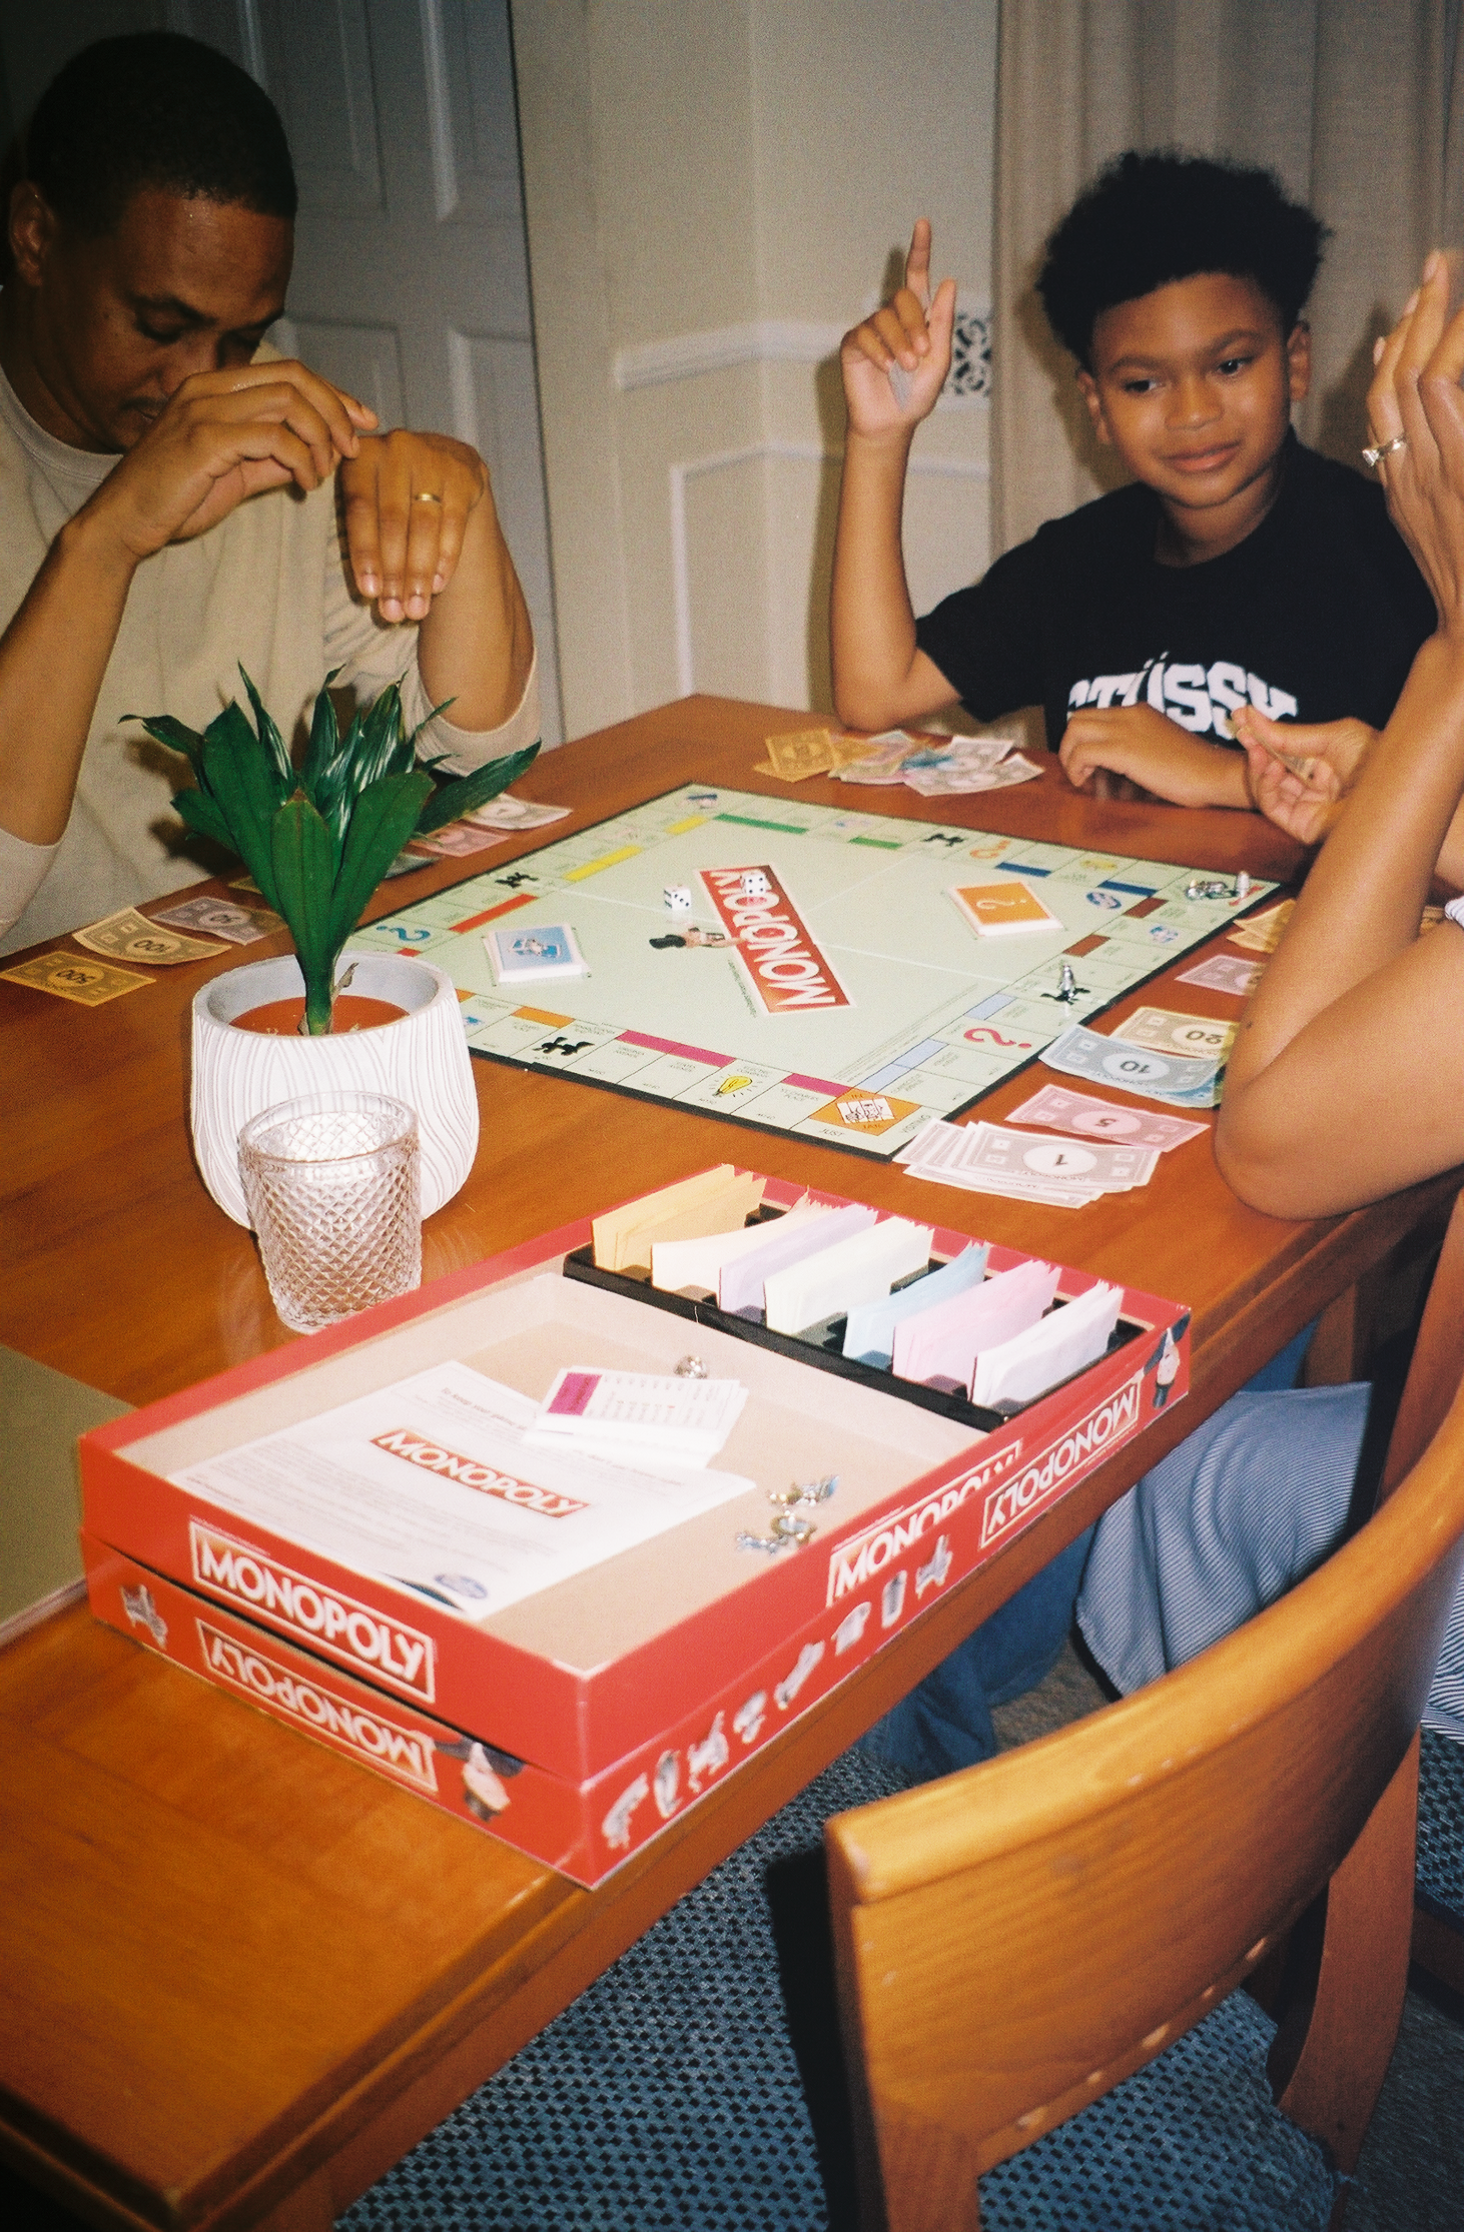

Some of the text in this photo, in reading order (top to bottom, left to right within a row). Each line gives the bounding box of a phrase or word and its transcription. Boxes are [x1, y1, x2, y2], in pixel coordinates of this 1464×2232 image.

[132, 938, 166, 954] 100
[55, 968, 97, 985] 500
[1184, 1030, 1225, 1046] 20
[1119, 1060, 1151, 1075] 10
[1094, 1117, 1117, 1128] 5
[821, 1128, 845, 1138] JUST
[1053, 1153, 1069, 1168] 1
[986, 1384, 1137, 1536] MONOPOLY
[378, 1431, 584, 1515] MONOPOLY
[201, 1537, 425, 1682] MONOPOLY
[211, 1637, 424, 1777] MONOPOLY
